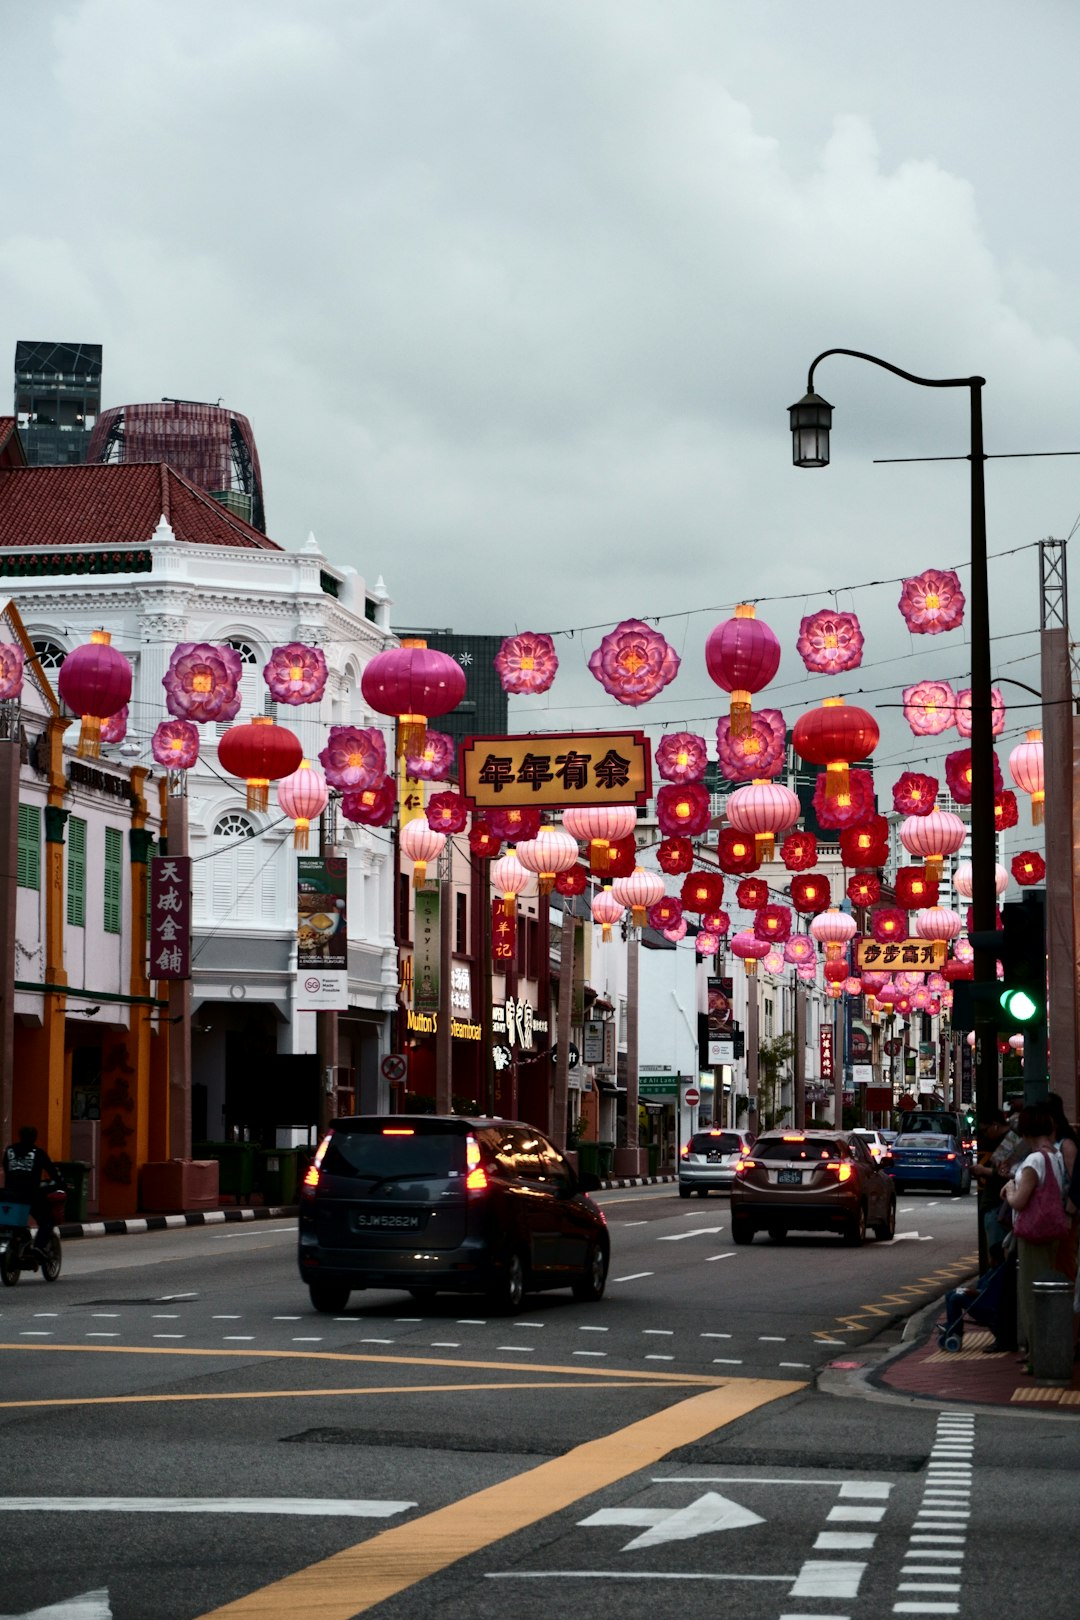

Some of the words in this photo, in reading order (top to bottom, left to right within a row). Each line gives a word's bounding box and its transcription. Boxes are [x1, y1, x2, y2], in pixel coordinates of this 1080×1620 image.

[479, 750, 631, 792] 年年有余
[864, 944, 937, 963] 步步高升
[307, 981, 318, 989] SG
[407, 1009, 432, 1033] Mutton
[450, 1016, 482, 1040] Steamboat
[552, 1052, 577, 1062] cft
[357, 1215, 419, 1227] SJW5262M
